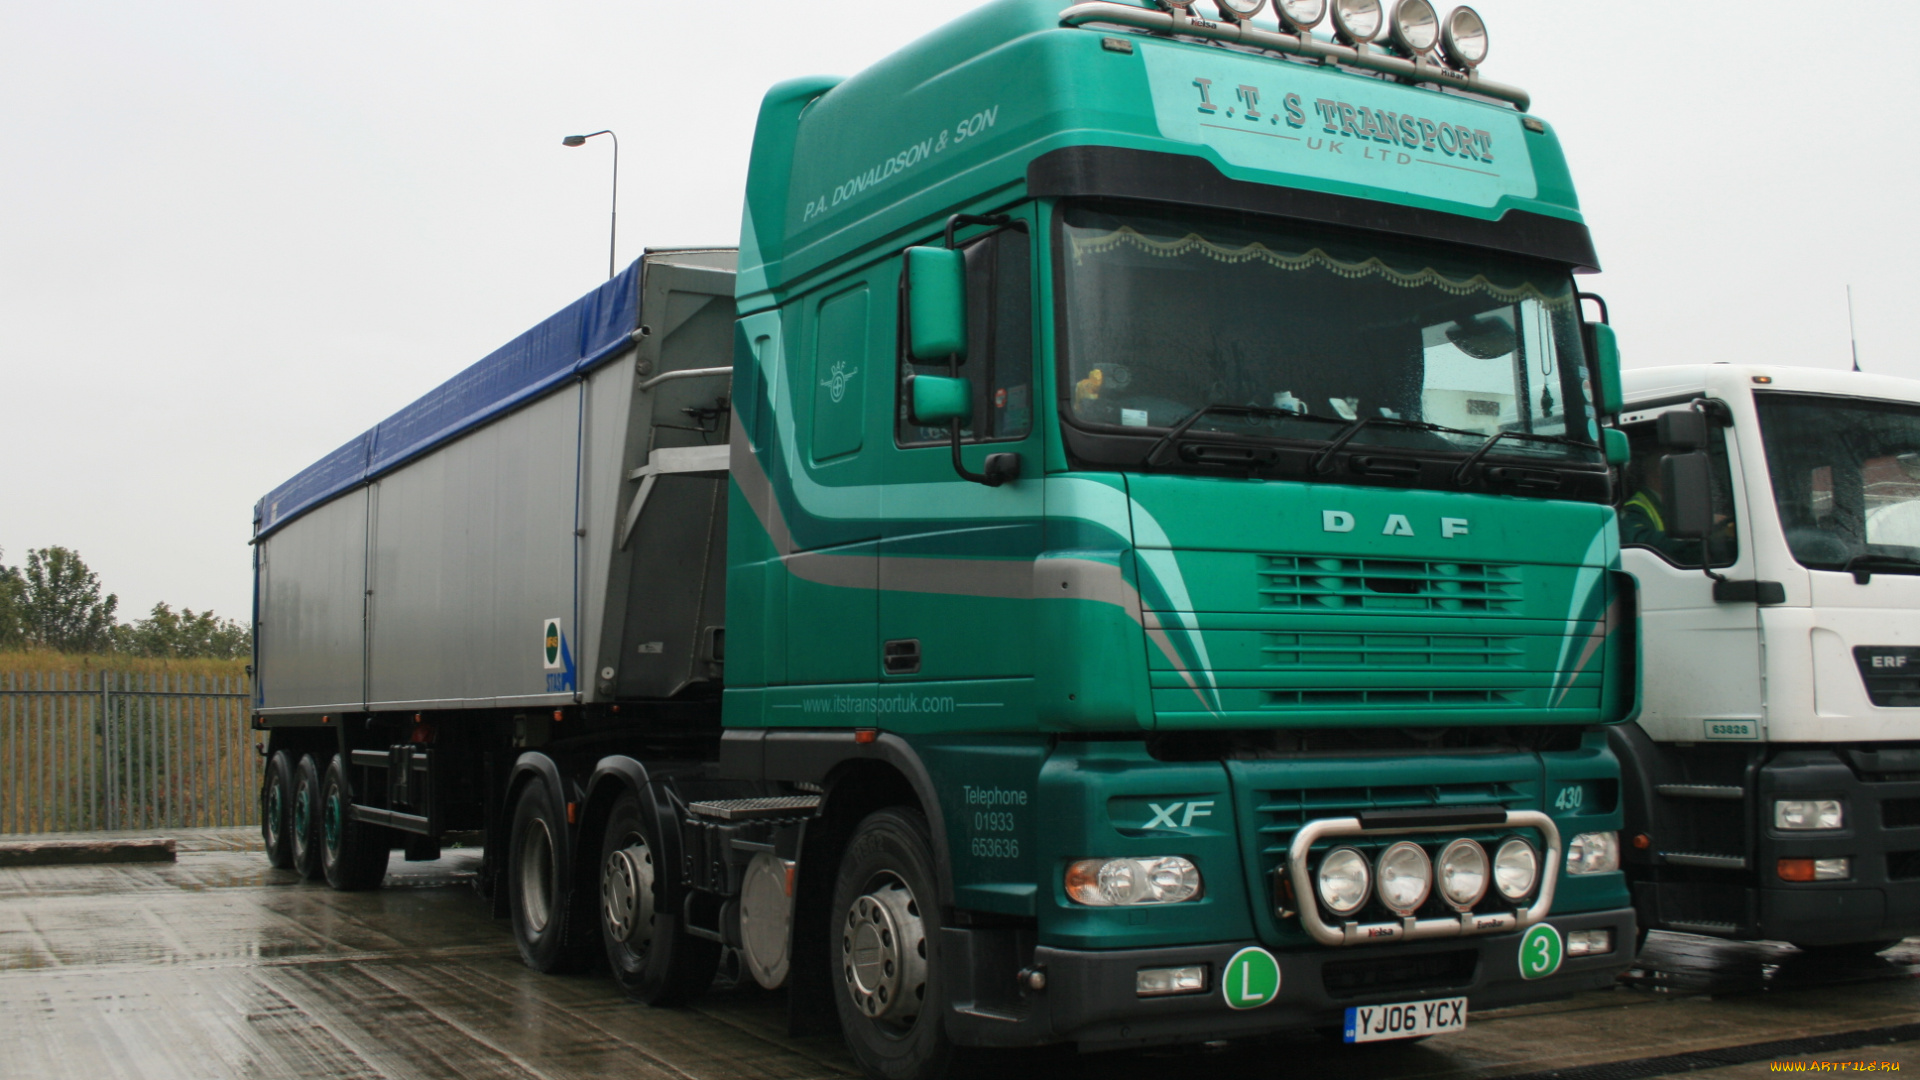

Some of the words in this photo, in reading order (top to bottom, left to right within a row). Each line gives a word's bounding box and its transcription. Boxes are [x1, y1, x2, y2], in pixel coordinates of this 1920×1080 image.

[1314, 98, 1495, 164] TRANSPORT
[803, 195, 828, 222] P.A.
[832, 137, 933, 207] DONALDSON
[935, 129, 949, 153] &
[953, 105, 999, 143] SON
[1306, 136, 1345, 155] UK
[1364, 146, 1412, 165] LTD
[1322, 510, 1469, 538] DAF
[1872, 656, 1906, 667] ERF
[803, 693, 954, 714] www.itstransportuk.com
[1712, 725, 1748, 735] 63828
[963, 785, 1028, 809] Telephone
[1555, 785, 1583, 810] 430
[975, 812, 1014, 831] 01933
[1142, 801, 1215, 829] XF
[971, 838, 1019, 858] 653636
[1531, 935, 1550, 973] 3
[1242, 961, 1263, 1001] L
[1360, 1004, 1417, 1035] YJ06
[1423, 999, 1463, 1029] YCX
